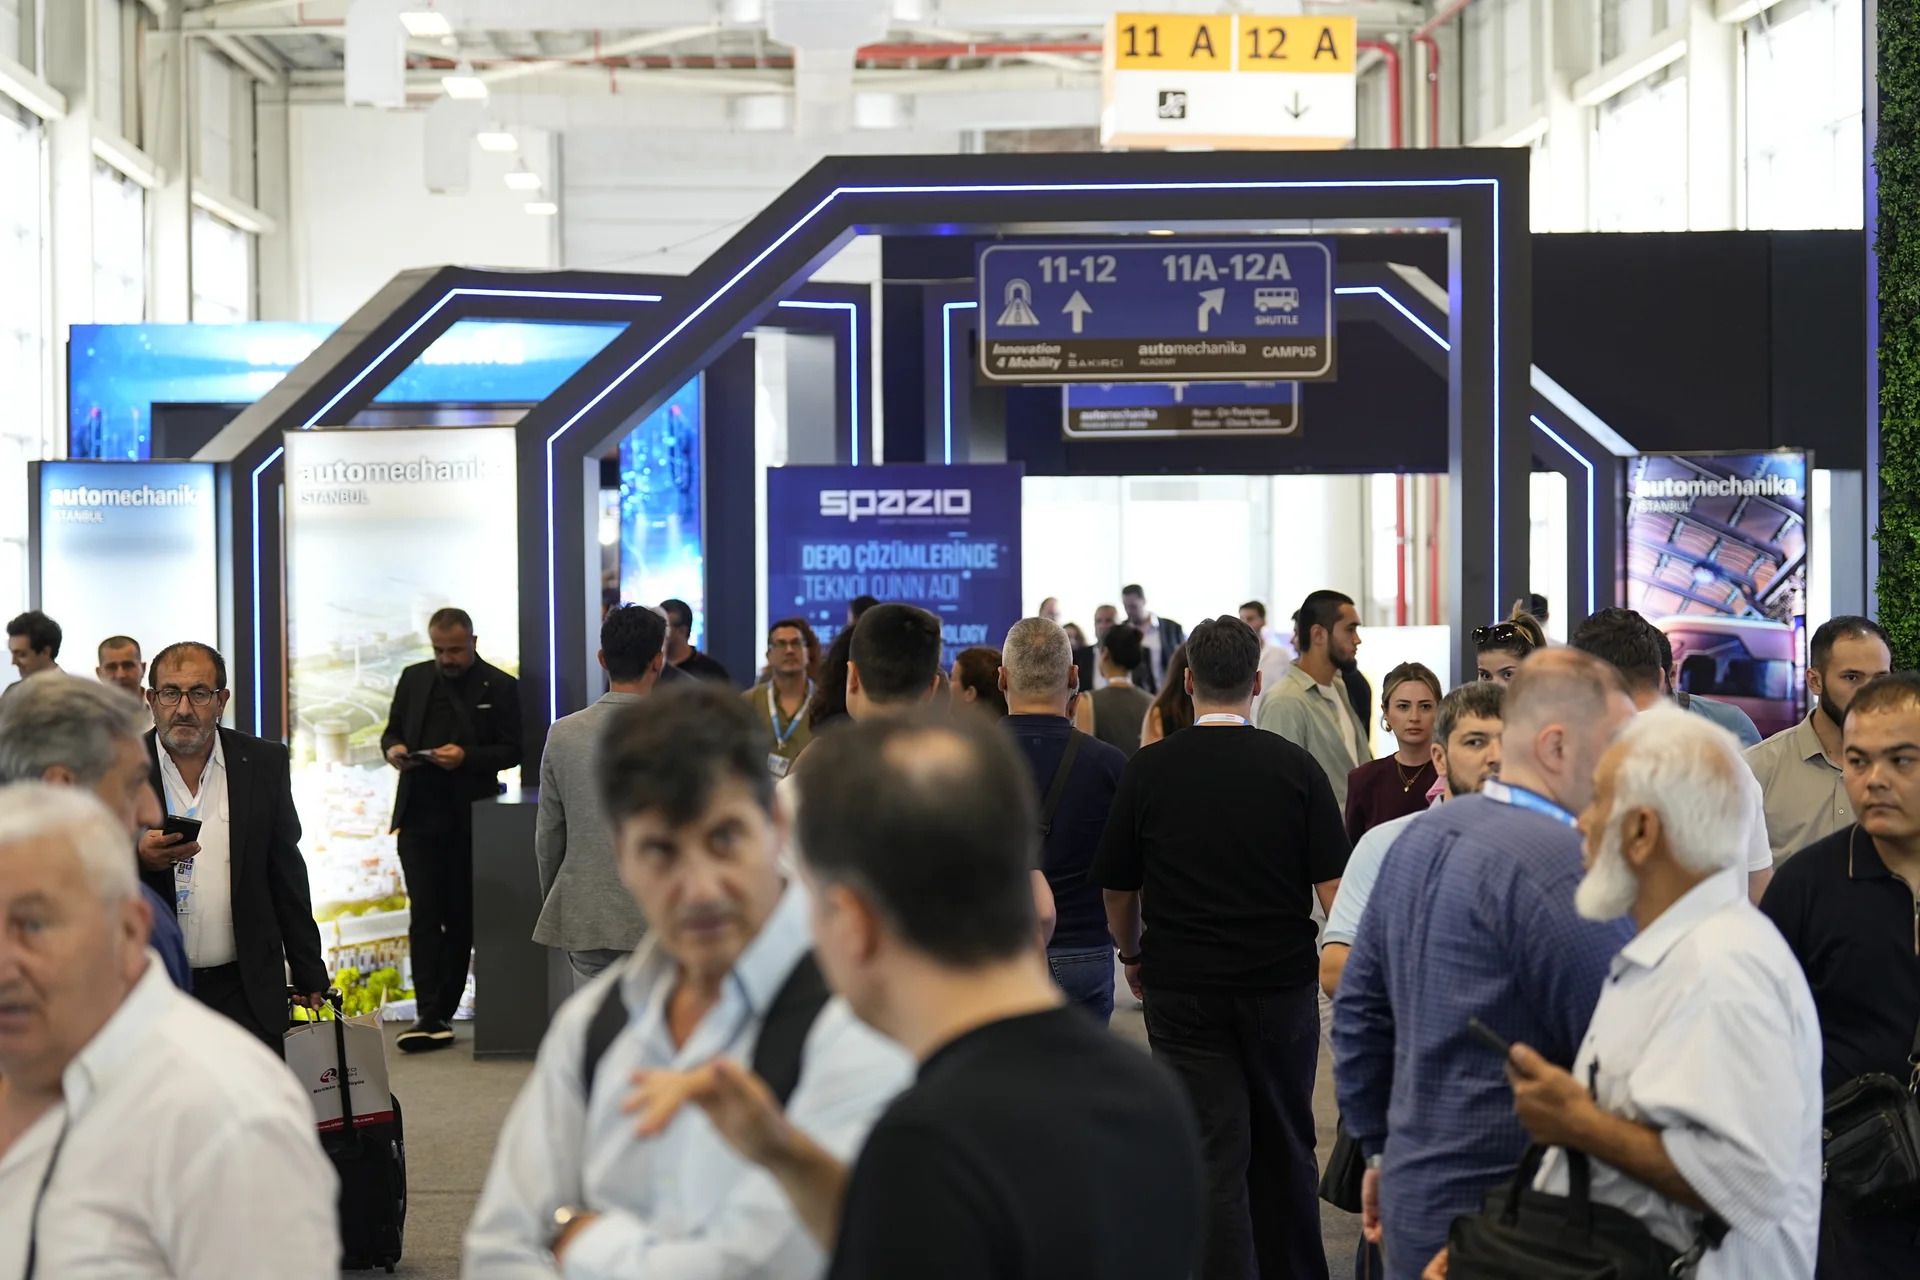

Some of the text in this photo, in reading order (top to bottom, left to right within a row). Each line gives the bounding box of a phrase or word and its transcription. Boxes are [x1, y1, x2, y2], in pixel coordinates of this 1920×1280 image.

[1122, 24, 1216, 58] 11 A
[1246, 27, 1339, 60] 12 A
[1038, 255, 1117, 283] 11-12
[1162, 254, 1291, 282] 11A-12A
[1255, 315, 1298, 325] SHUTTLE
[992, 342, 1061, 355] Innovation
[1138, 341, 1246, 355] automechanika
[1262, 346, 1317, 358] CAMPUS
[996, 356, 1062, 370] 4 Mobility
[1635, 474, 1797, 498] automechanika
[819, 489, 972, 522] spazio
[802, 540, 999, 573] DEPO ÇÖZÜMLERİNDE
